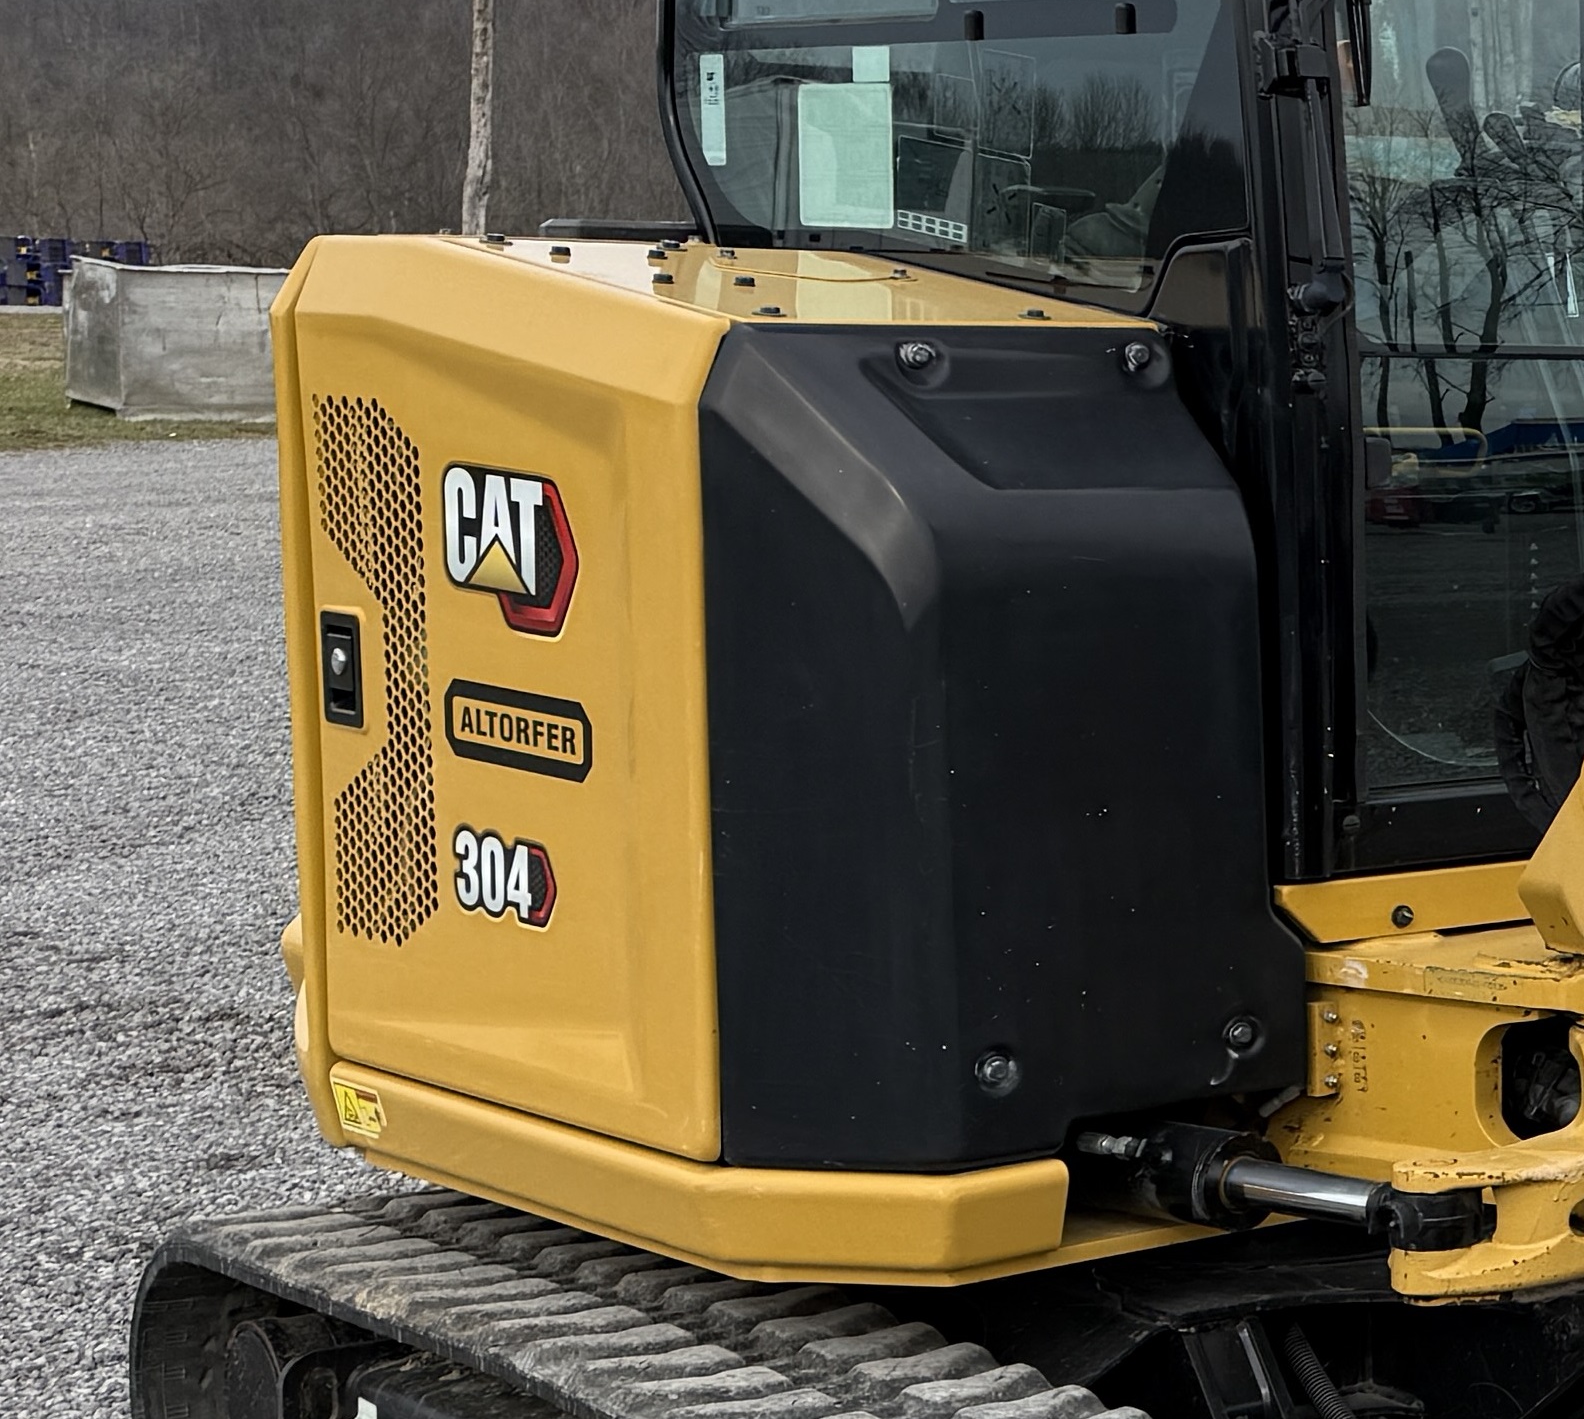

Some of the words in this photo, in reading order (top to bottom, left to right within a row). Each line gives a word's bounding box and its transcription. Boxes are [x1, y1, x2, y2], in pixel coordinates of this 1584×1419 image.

[444, 466, 543, 596] CAT
[459, 706, 577, 756] ALTORFER
[455, 830, 533, 920] 304
